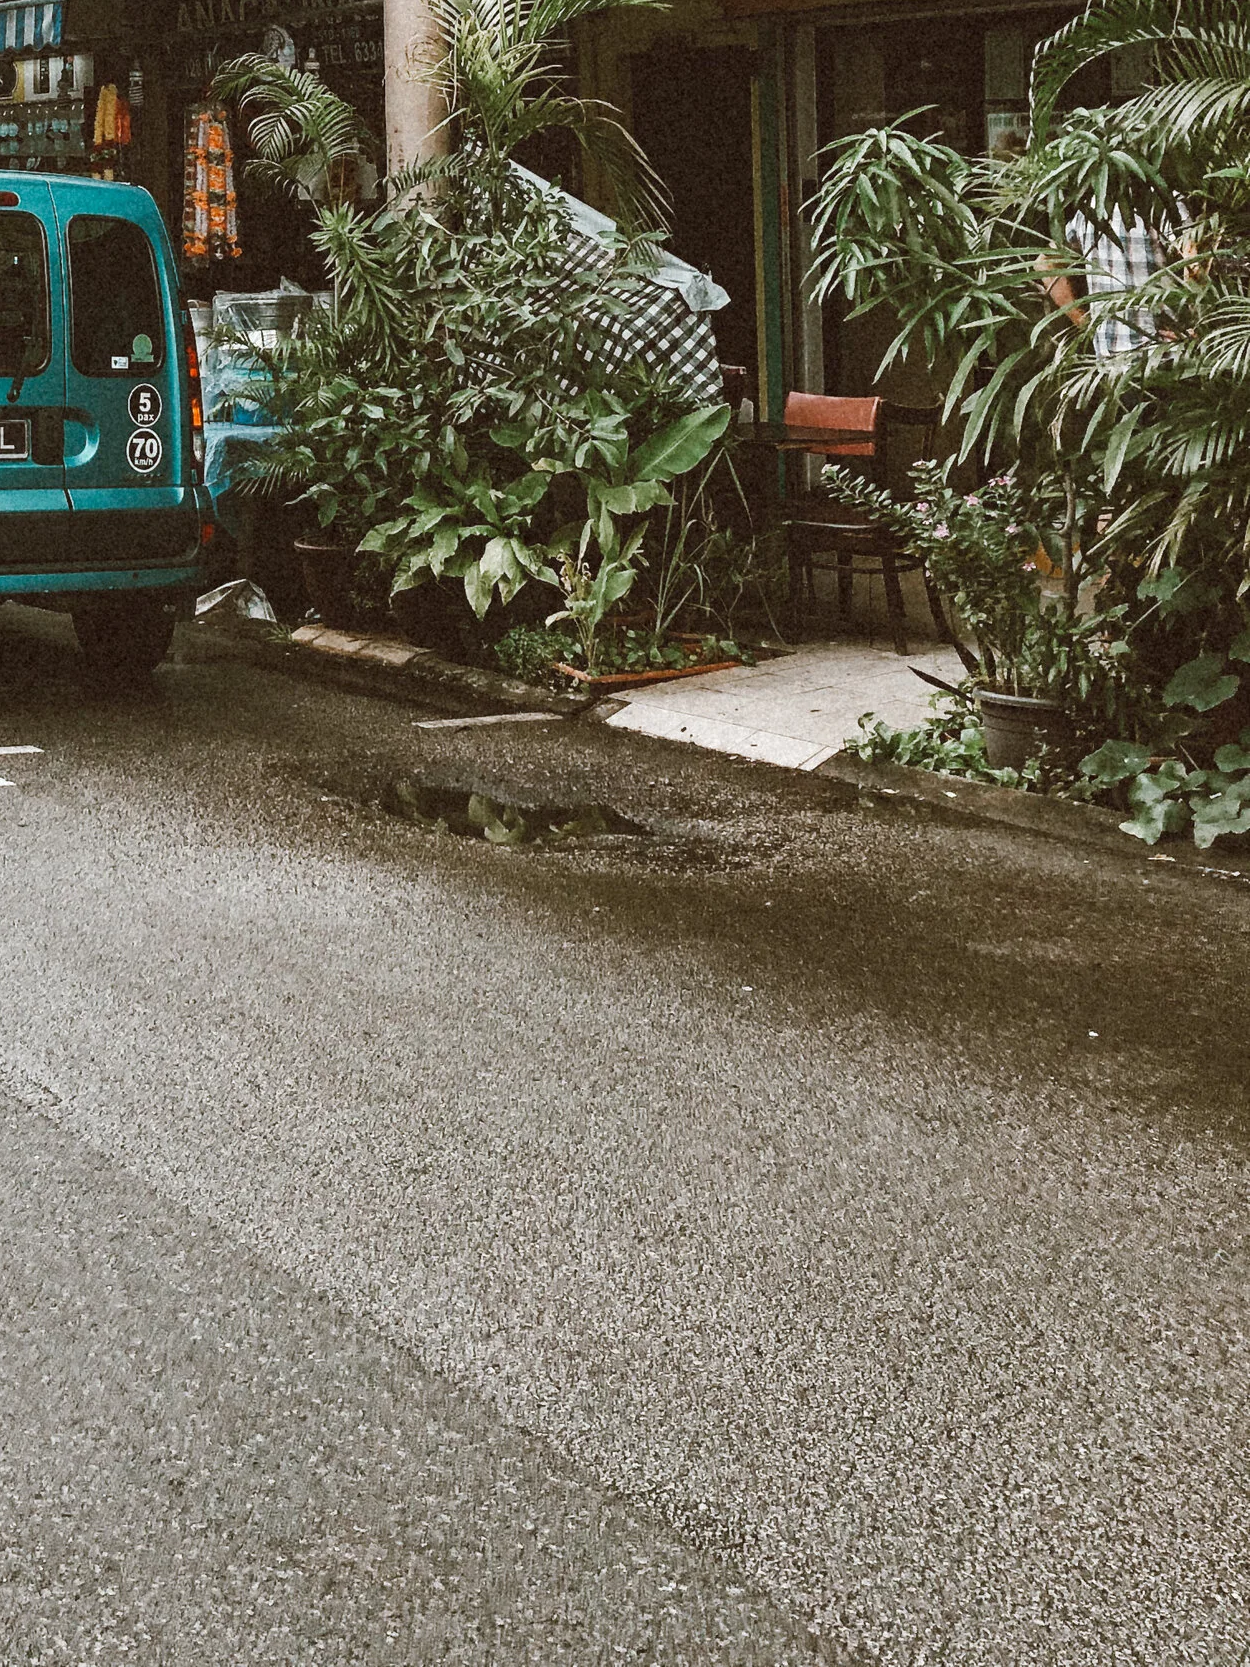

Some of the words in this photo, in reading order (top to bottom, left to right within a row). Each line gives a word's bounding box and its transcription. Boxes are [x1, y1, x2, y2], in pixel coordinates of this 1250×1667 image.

[138, 392, 152, 413] 5
[137, 412, 155, 423] pax
[132, 437, 158, 458] 70
[134, 457, 154, 466] km/h
